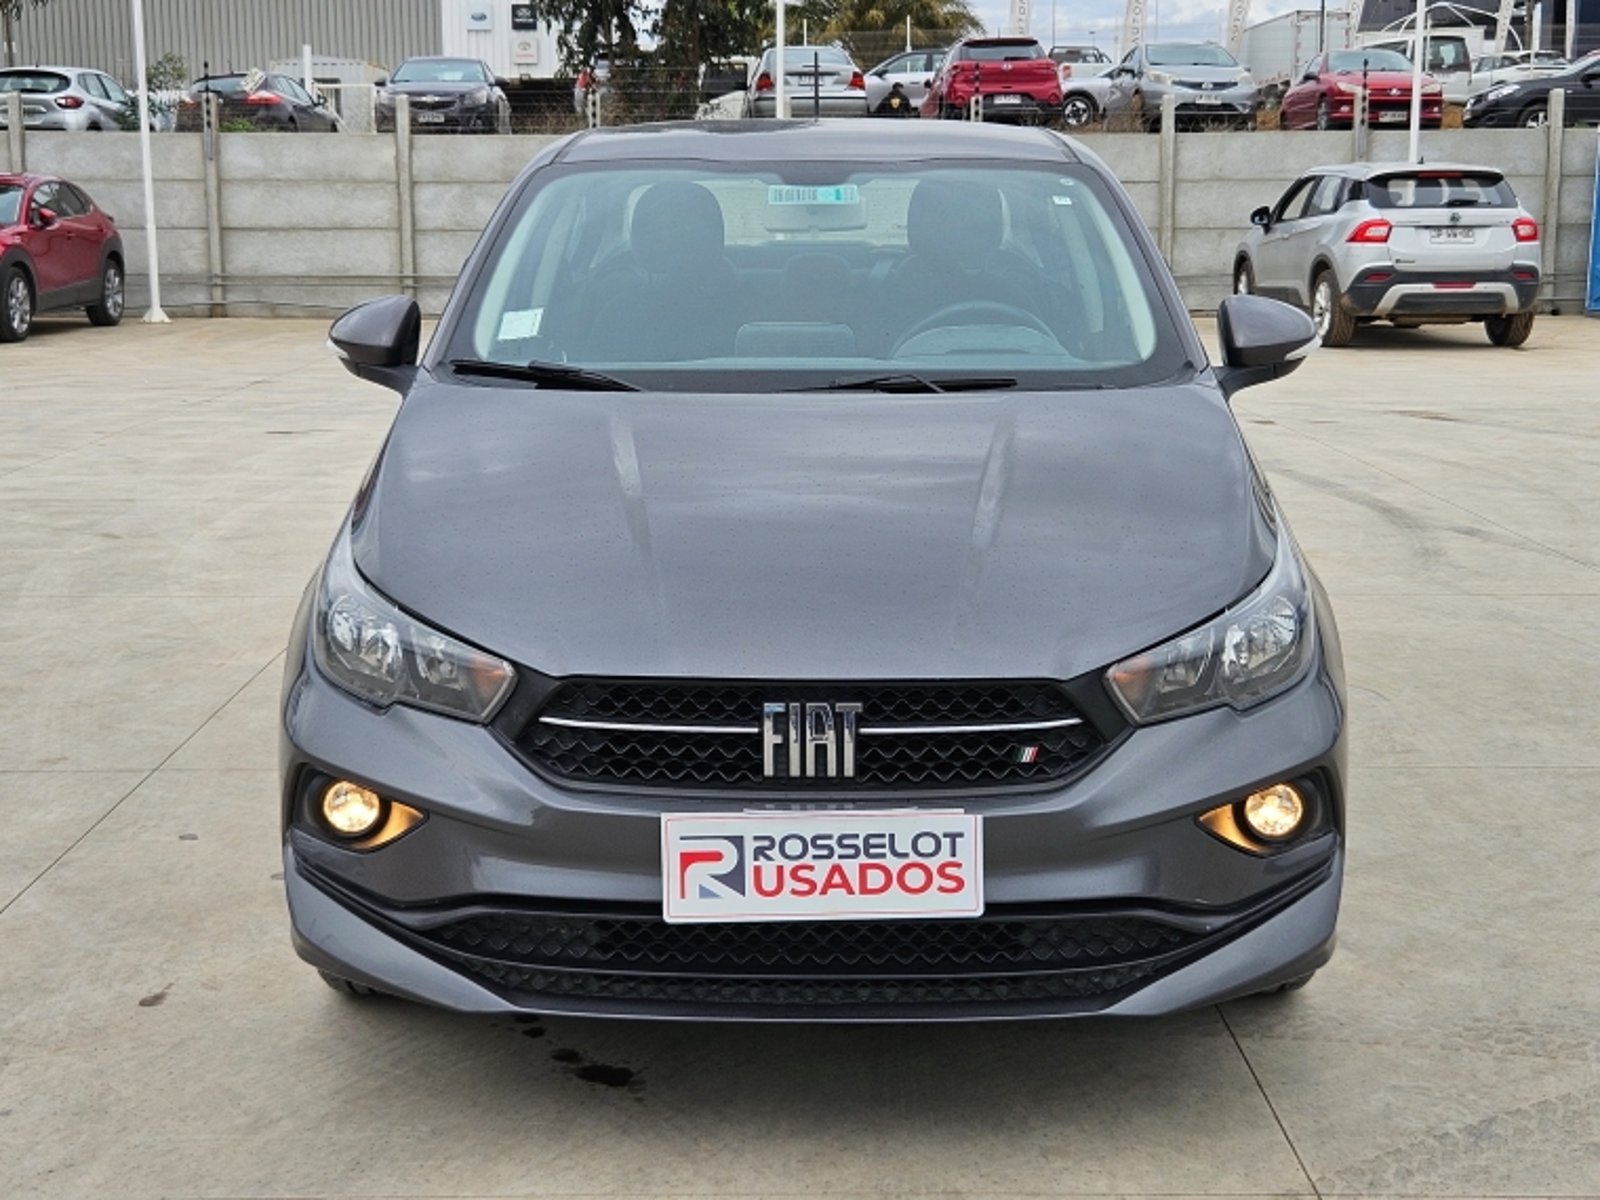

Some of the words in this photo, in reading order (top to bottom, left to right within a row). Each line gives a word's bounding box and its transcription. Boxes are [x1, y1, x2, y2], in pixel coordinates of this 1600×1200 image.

[763, 702, 863, 777] FIAT
[752, 831, 965, 862] ROSSELOT
[752, 862, 966, 898] USADOS
